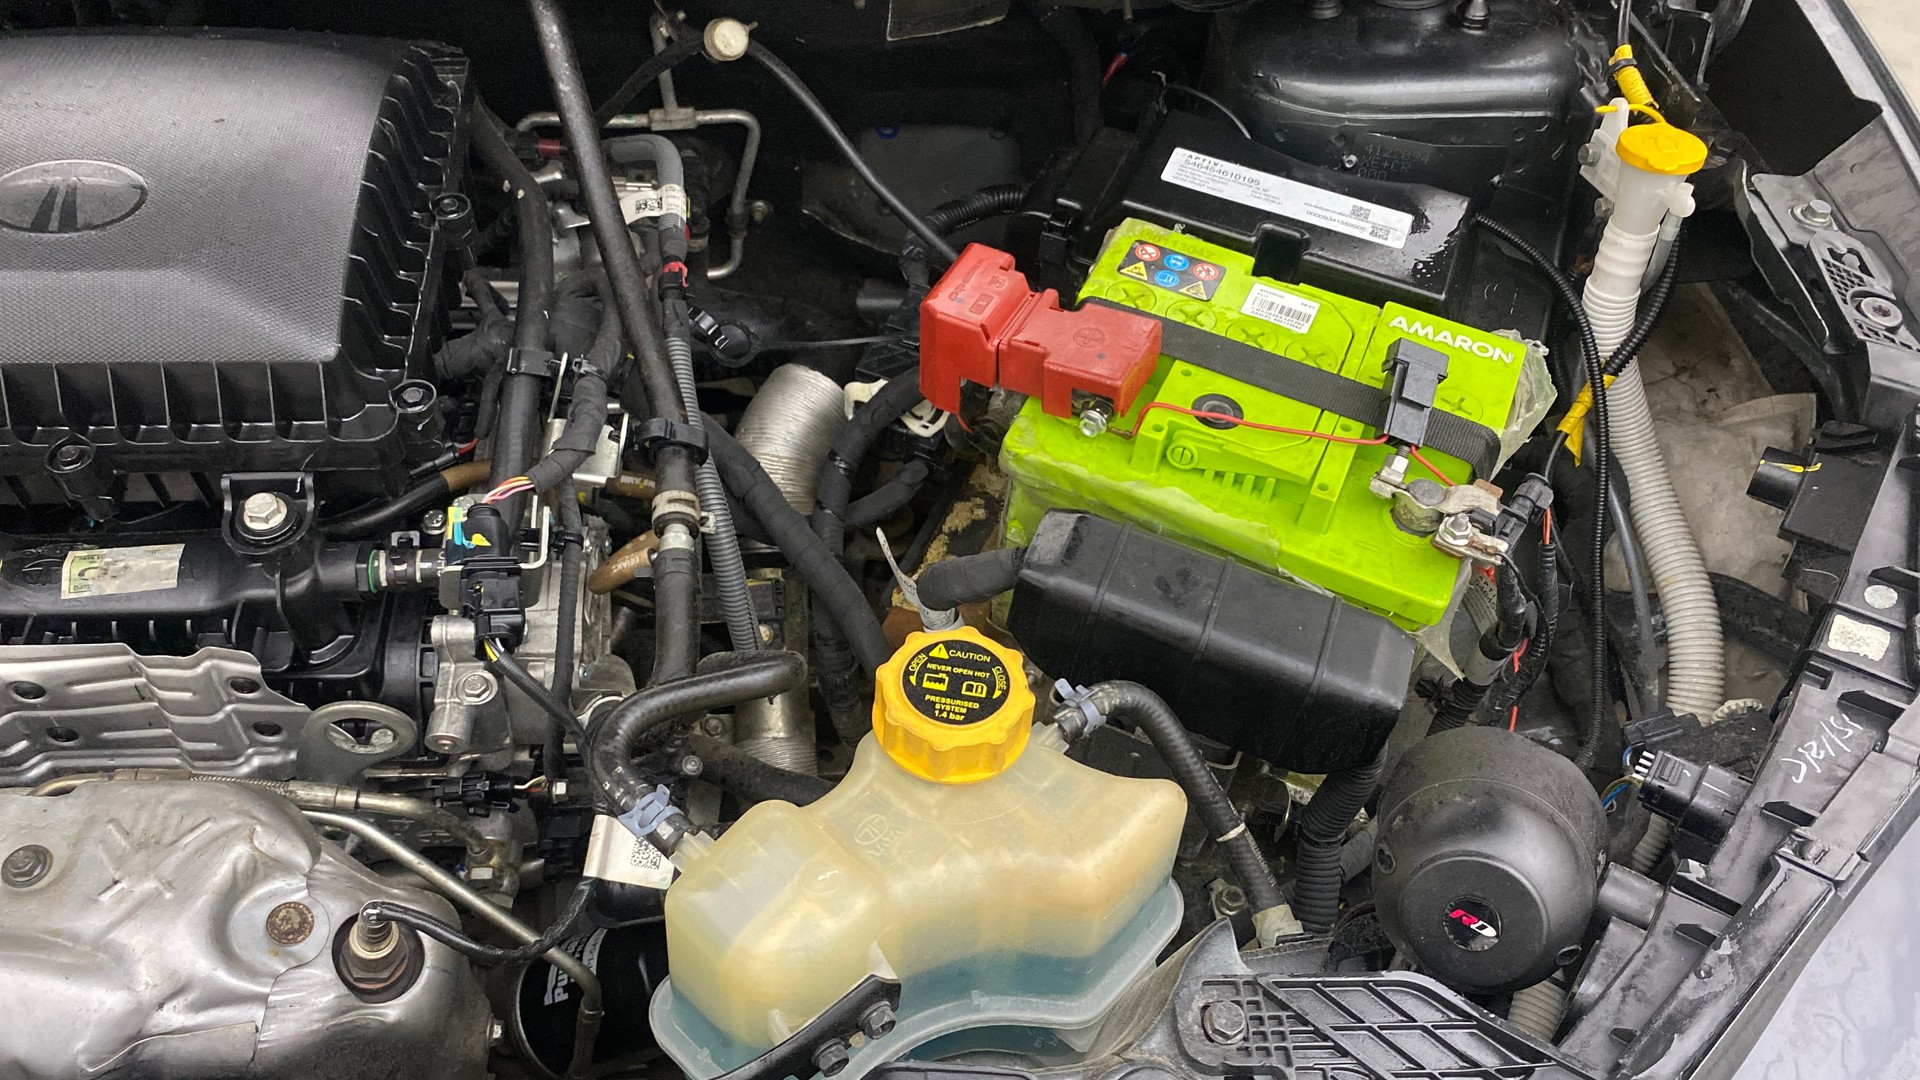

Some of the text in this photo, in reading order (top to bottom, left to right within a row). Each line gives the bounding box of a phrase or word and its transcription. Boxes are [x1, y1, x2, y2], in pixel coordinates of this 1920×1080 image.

[1187, 153, 1219, 167] APTIV
[1388, 315, 1515, 364] AMARON
[908, 653, 926, 671] OPEN
[949, 650, 991, 662] CAUTION
[926, 662, 952, 672] NEVER
[953, 667, 974, 676] OPEN
[995, 666, 1006, 690] CLOSE
[925, 694, 980, 709] PRESSURISED
[935, 703, 967, 714] SYSTEM
[934, 710, 965, 721] 1.4 bar
